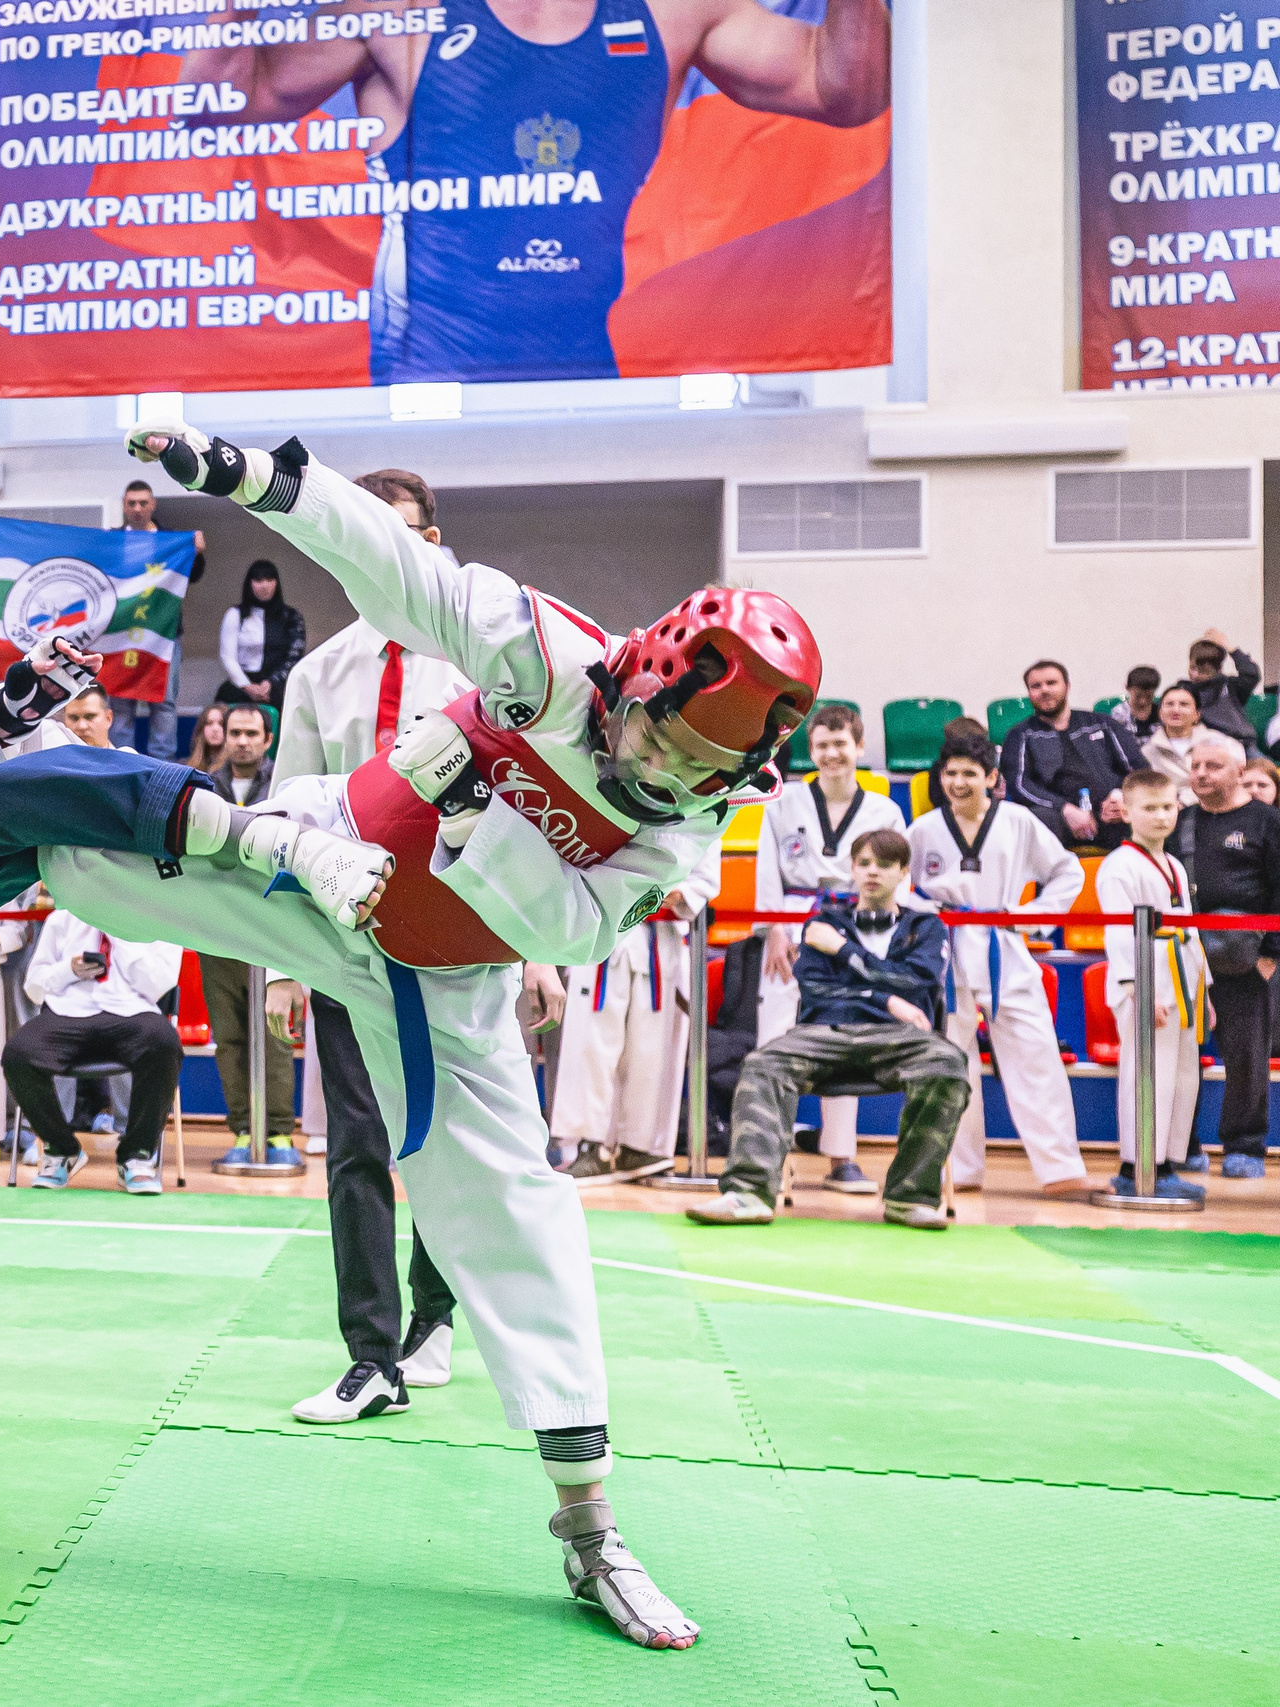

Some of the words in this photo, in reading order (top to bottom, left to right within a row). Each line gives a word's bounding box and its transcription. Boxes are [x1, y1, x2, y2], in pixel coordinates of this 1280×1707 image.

[0, 35, 40, 63] ПО
[46, 11, 308, 59] ГРЕКО-РИМСКОЙ
[315, 7, 447, 41] БОРЬБЕ
[1107, 11, 1244, 62] ГЕРОЙ
[1107, 59, 1280, 102] ФЕДЕРА
[0, 81, 247, 126] ПОБЕДИТЕЛЬ
[0, 120, 298, 169] ОЛИМПИЙСКИХ
[307, 117, 386, 151] ИГР
[266, 177, 469, 219] ЧЕМПИОН
[479, 170, 603, 208] МИРА
[1108, 226, 1280, 267] 9-КРАТН
[196, 289, 371, 327] ЕВРОПЫ
[1109, 271, 1236, 308] МИРА
[1112, 332, 1280, 372] 12-КРАТ
[434, 751, 467, 780] KHAN
